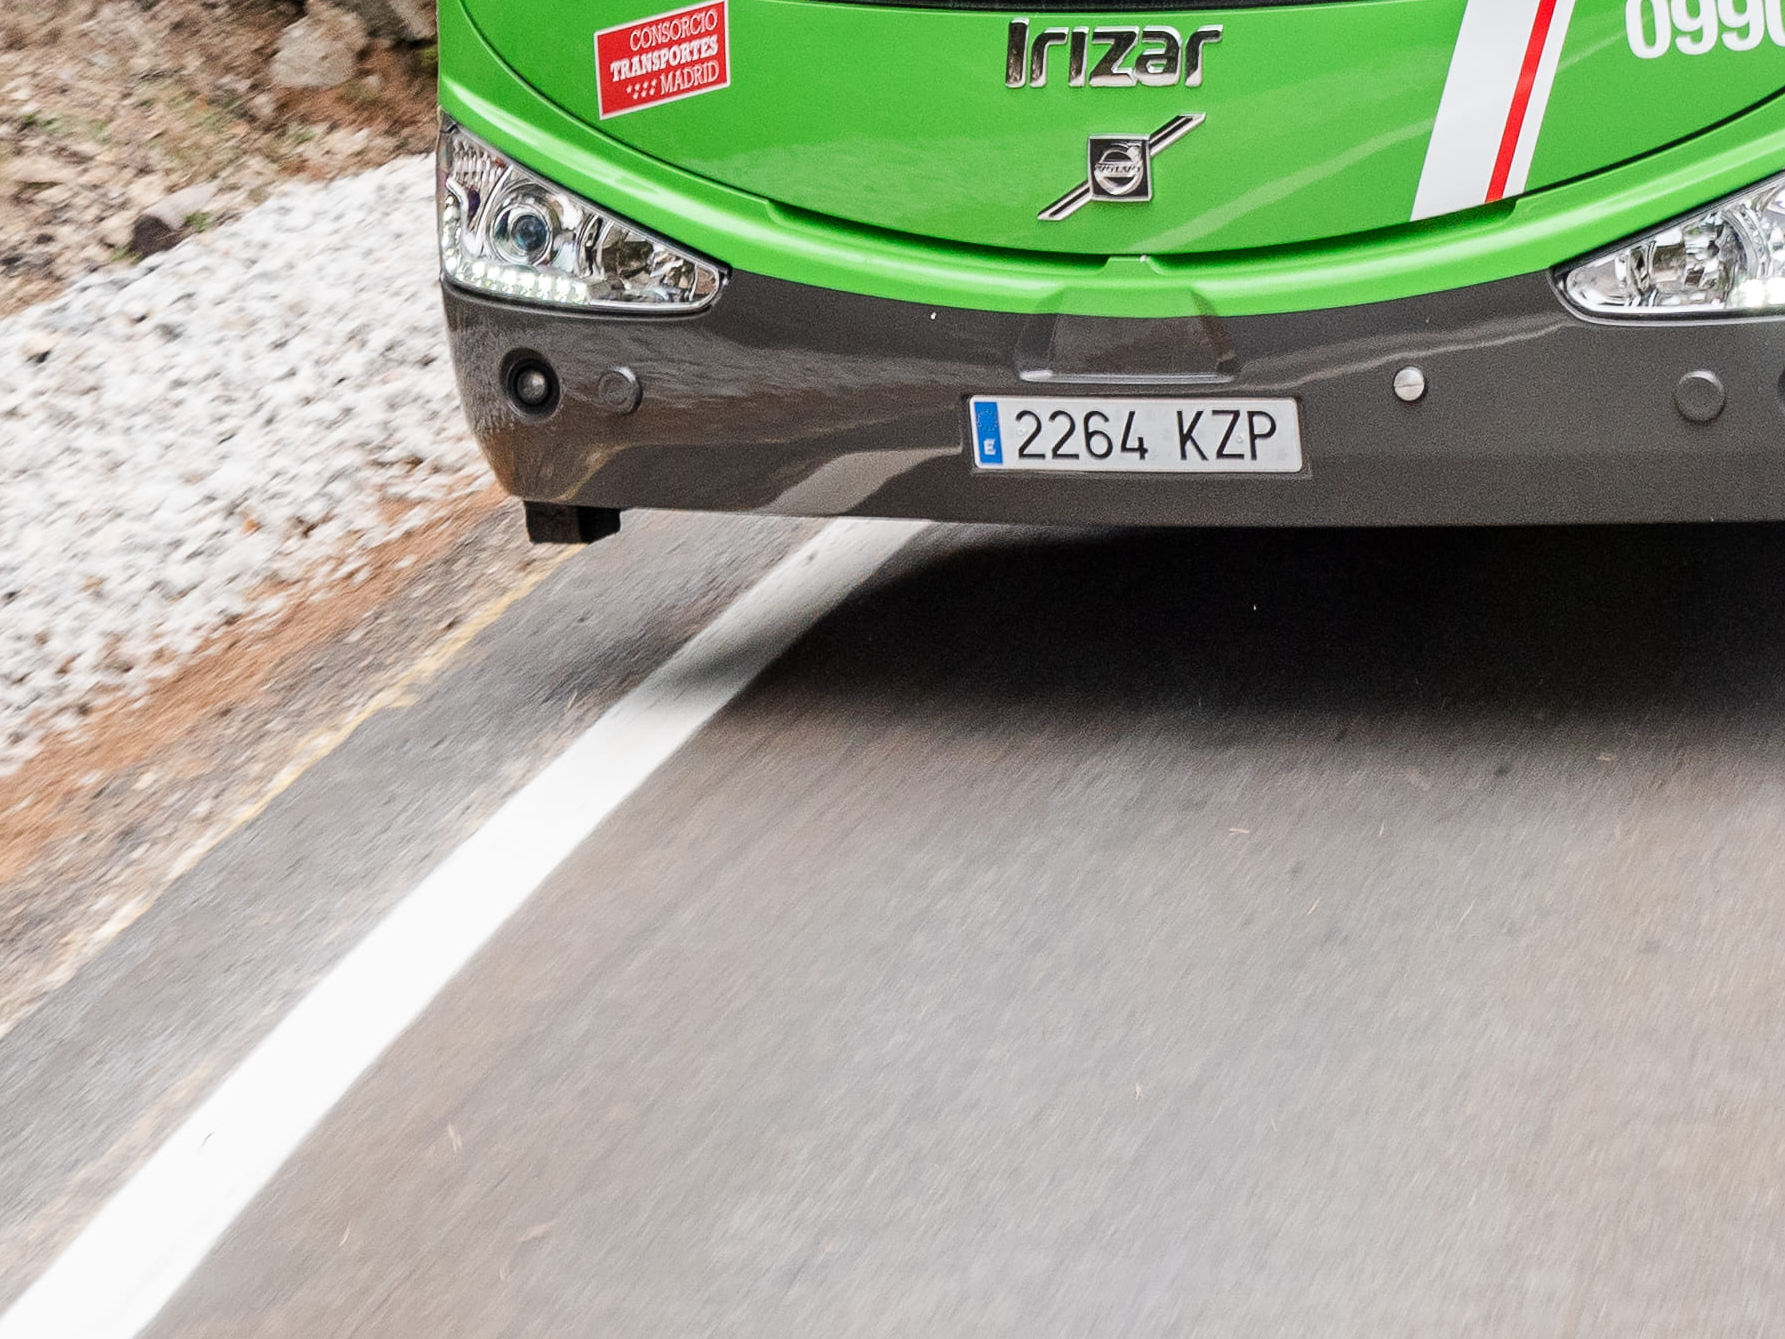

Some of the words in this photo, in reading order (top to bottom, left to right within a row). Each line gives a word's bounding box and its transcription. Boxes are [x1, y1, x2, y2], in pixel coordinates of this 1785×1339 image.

[629, 8, 718, 52] CONSORCIO
[609, 34, 719, 83] TRANSPORTES
[660, 60, 720, 96] MADRID
[983, 438, 997, 455] E
[1014, 409, 1149, 461] 2264
[1175, 409, 1277, 461] KZP
